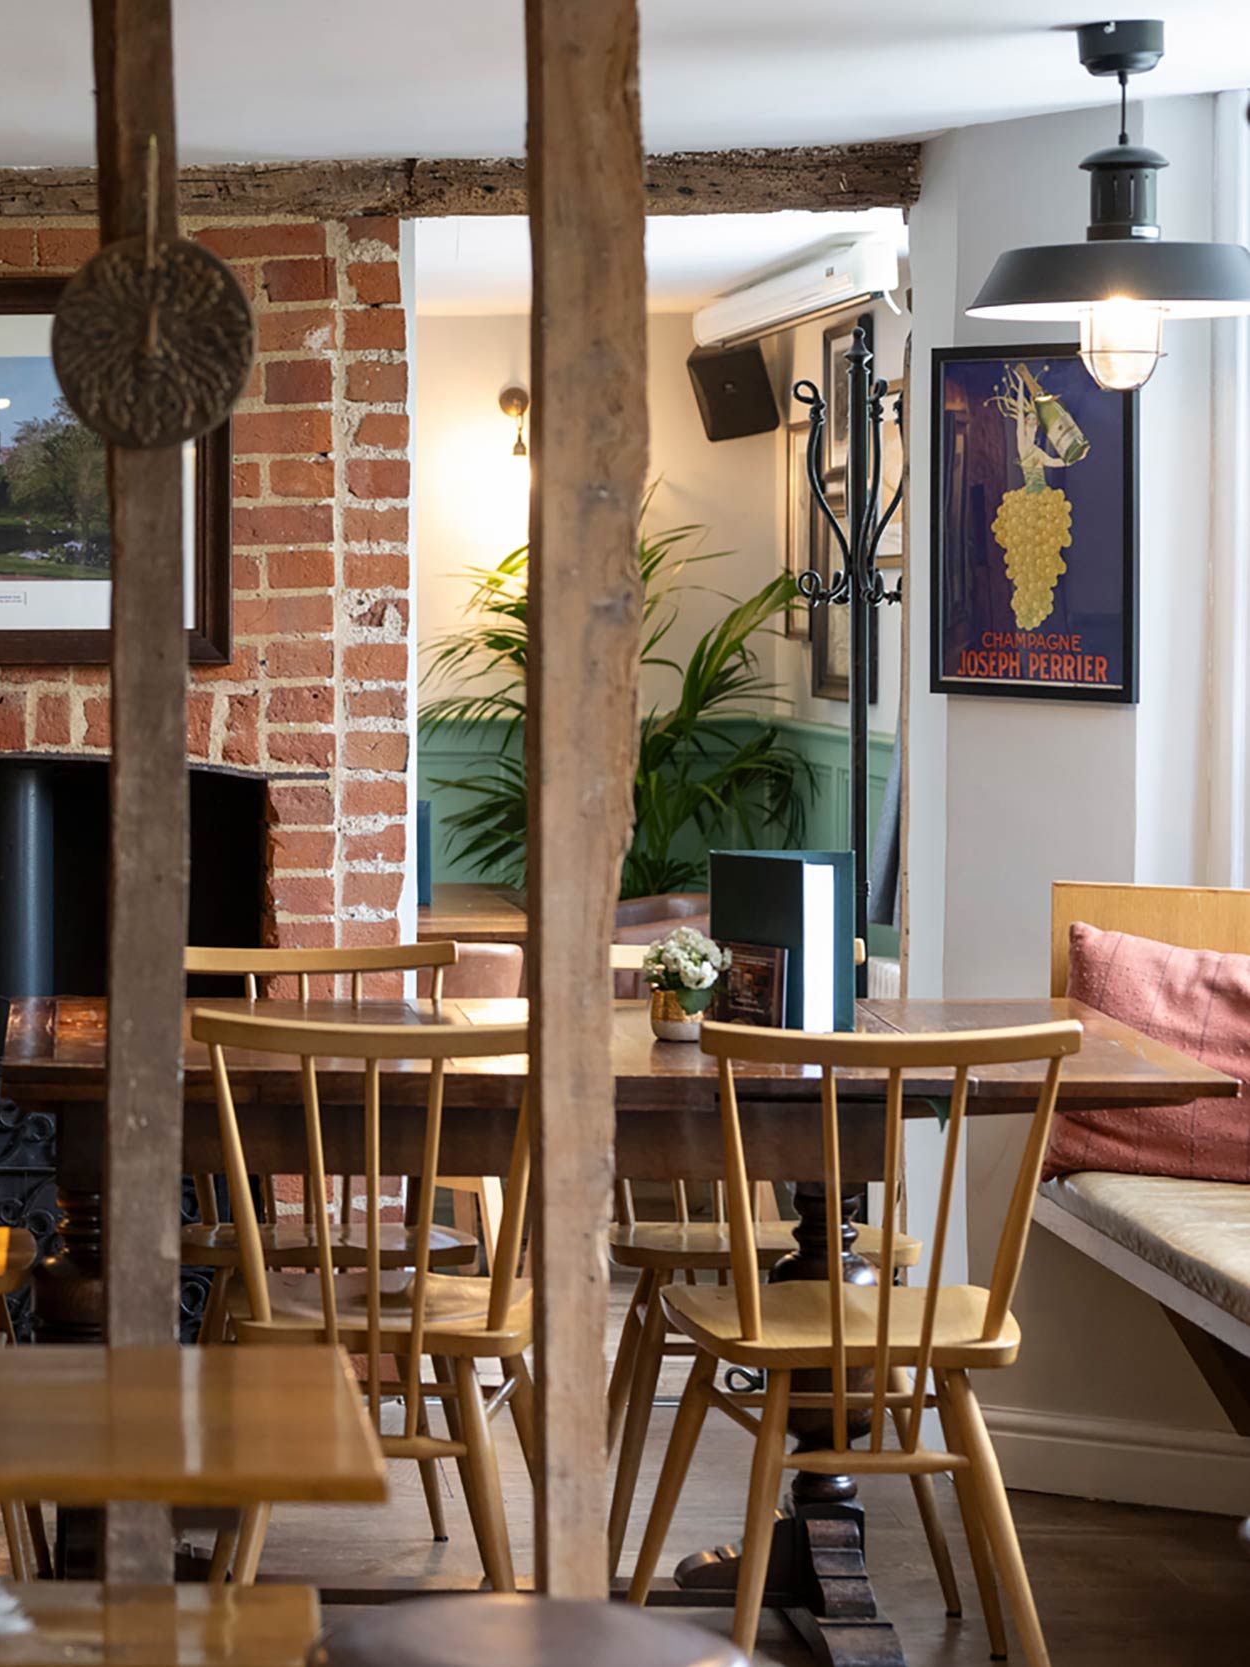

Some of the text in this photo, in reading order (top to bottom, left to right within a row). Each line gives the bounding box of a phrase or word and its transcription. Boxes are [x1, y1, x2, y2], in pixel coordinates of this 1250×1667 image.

[981, 631, 1082, 652] CHAMPAGNE
[957, 650, 1108, 682] JOSEPH PERRIER
